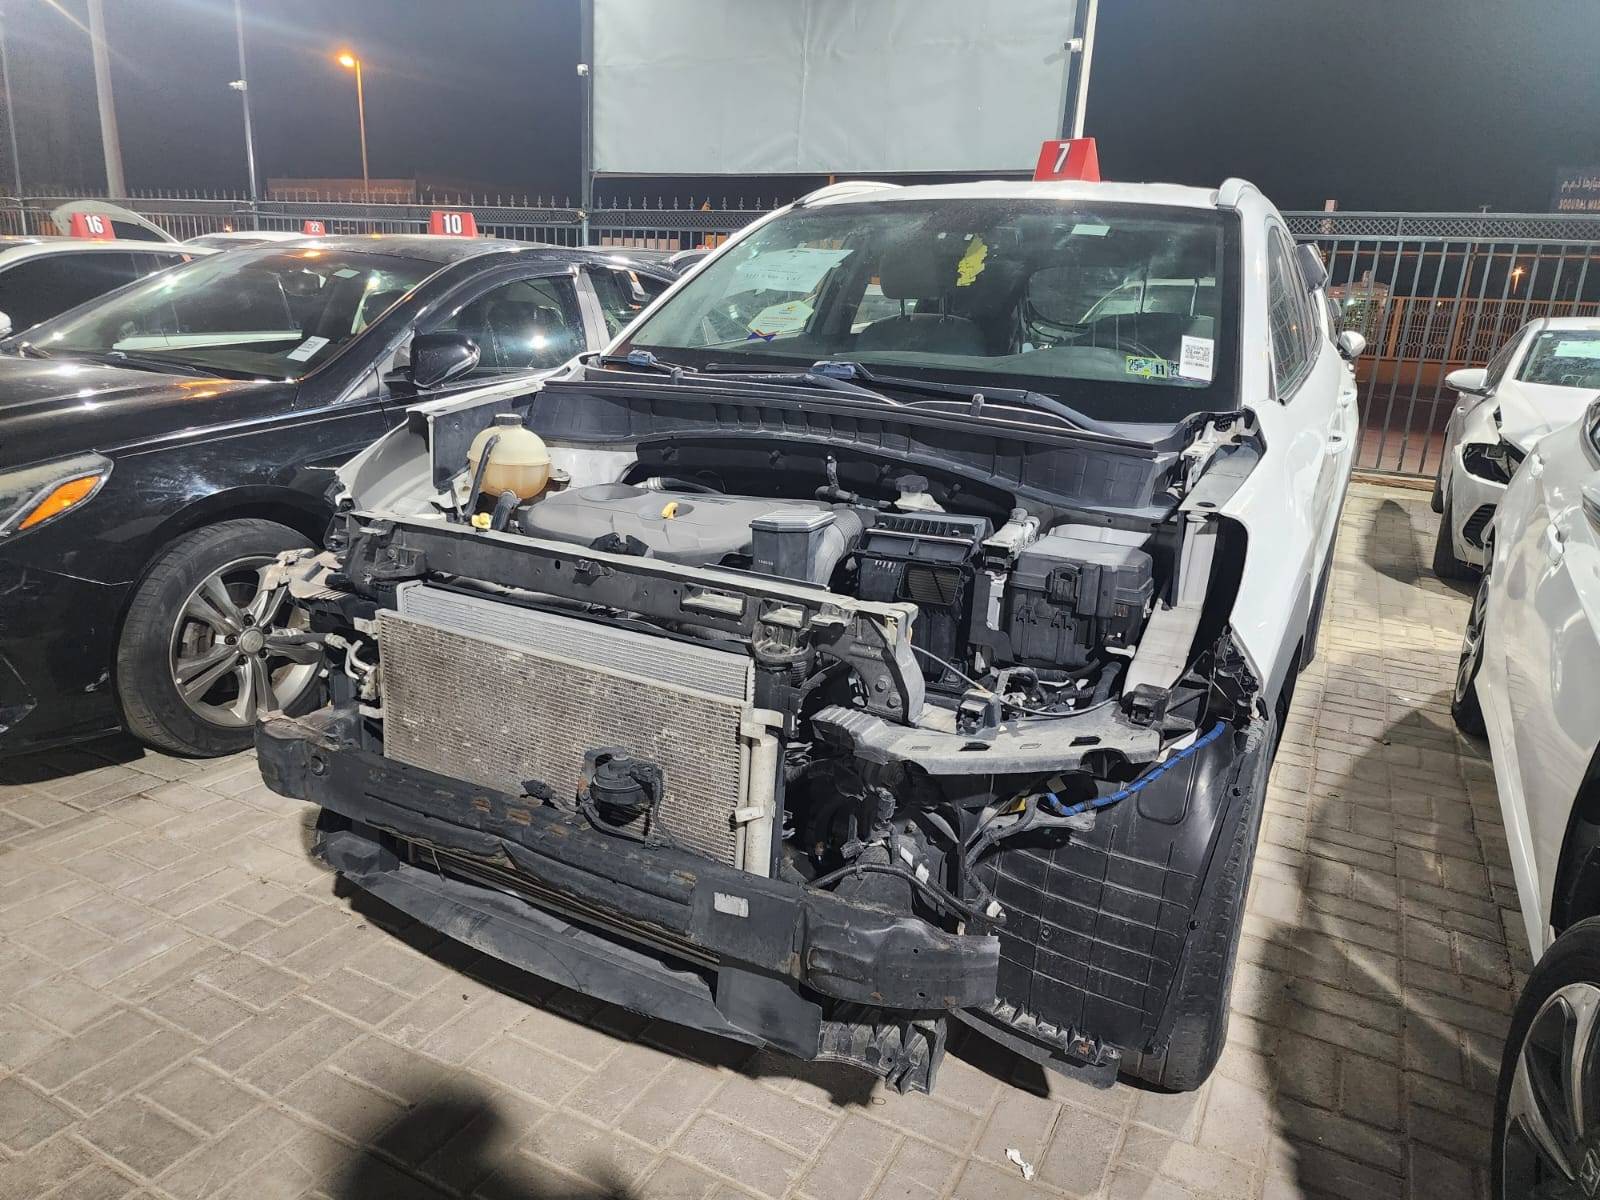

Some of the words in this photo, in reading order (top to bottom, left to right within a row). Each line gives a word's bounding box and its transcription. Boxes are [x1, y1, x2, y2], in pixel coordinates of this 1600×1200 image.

[1053, 142, 1070, 173] 7
[85, 215, 104, 234] 16
[443, 214, 462, 234] 10
[1155, 364, 1165, 376] 11
